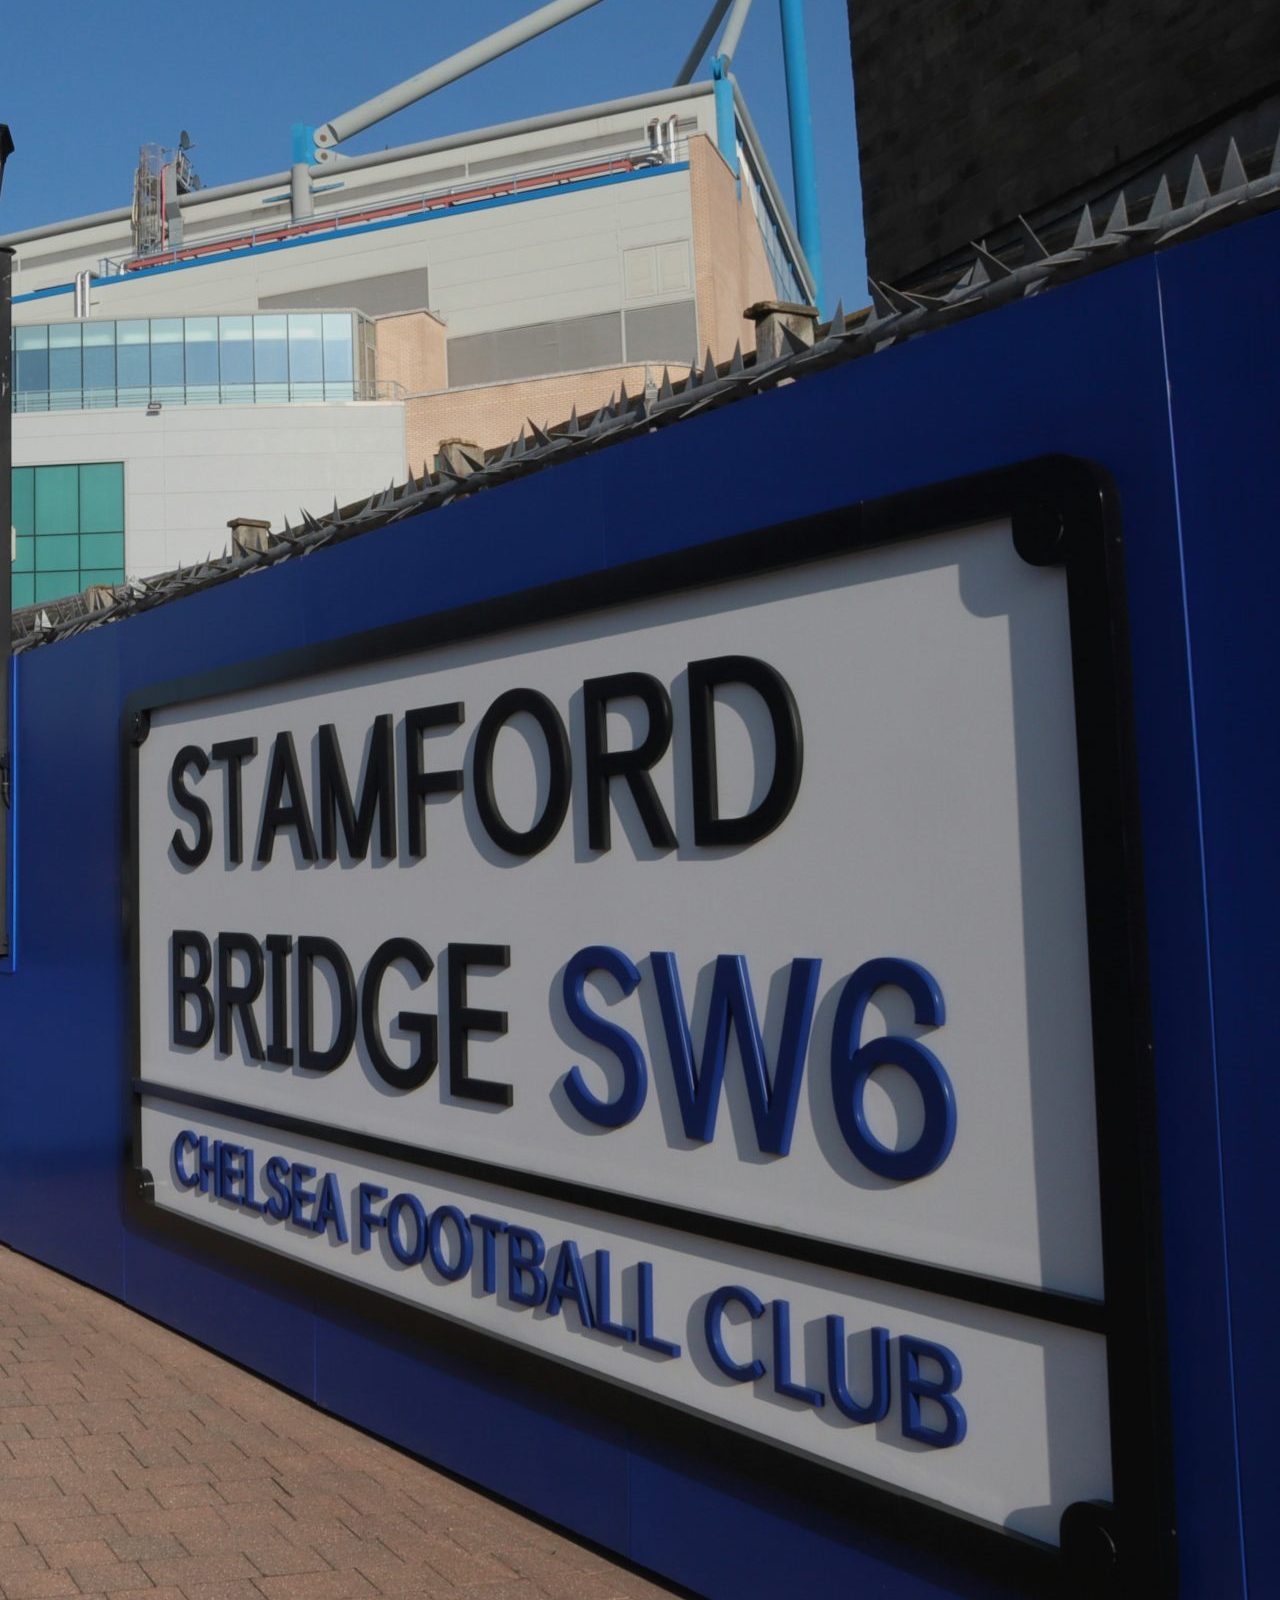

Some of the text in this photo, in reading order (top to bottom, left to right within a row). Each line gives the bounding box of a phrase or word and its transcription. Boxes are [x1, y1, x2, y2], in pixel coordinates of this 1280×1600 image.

[171, 655, 804, 867] STAMFORD
[172, 930, 957, 1181] BRIDGE SW6
[173, 1129, 968, 1449] CHELSEA FOOTBALL CLUB
